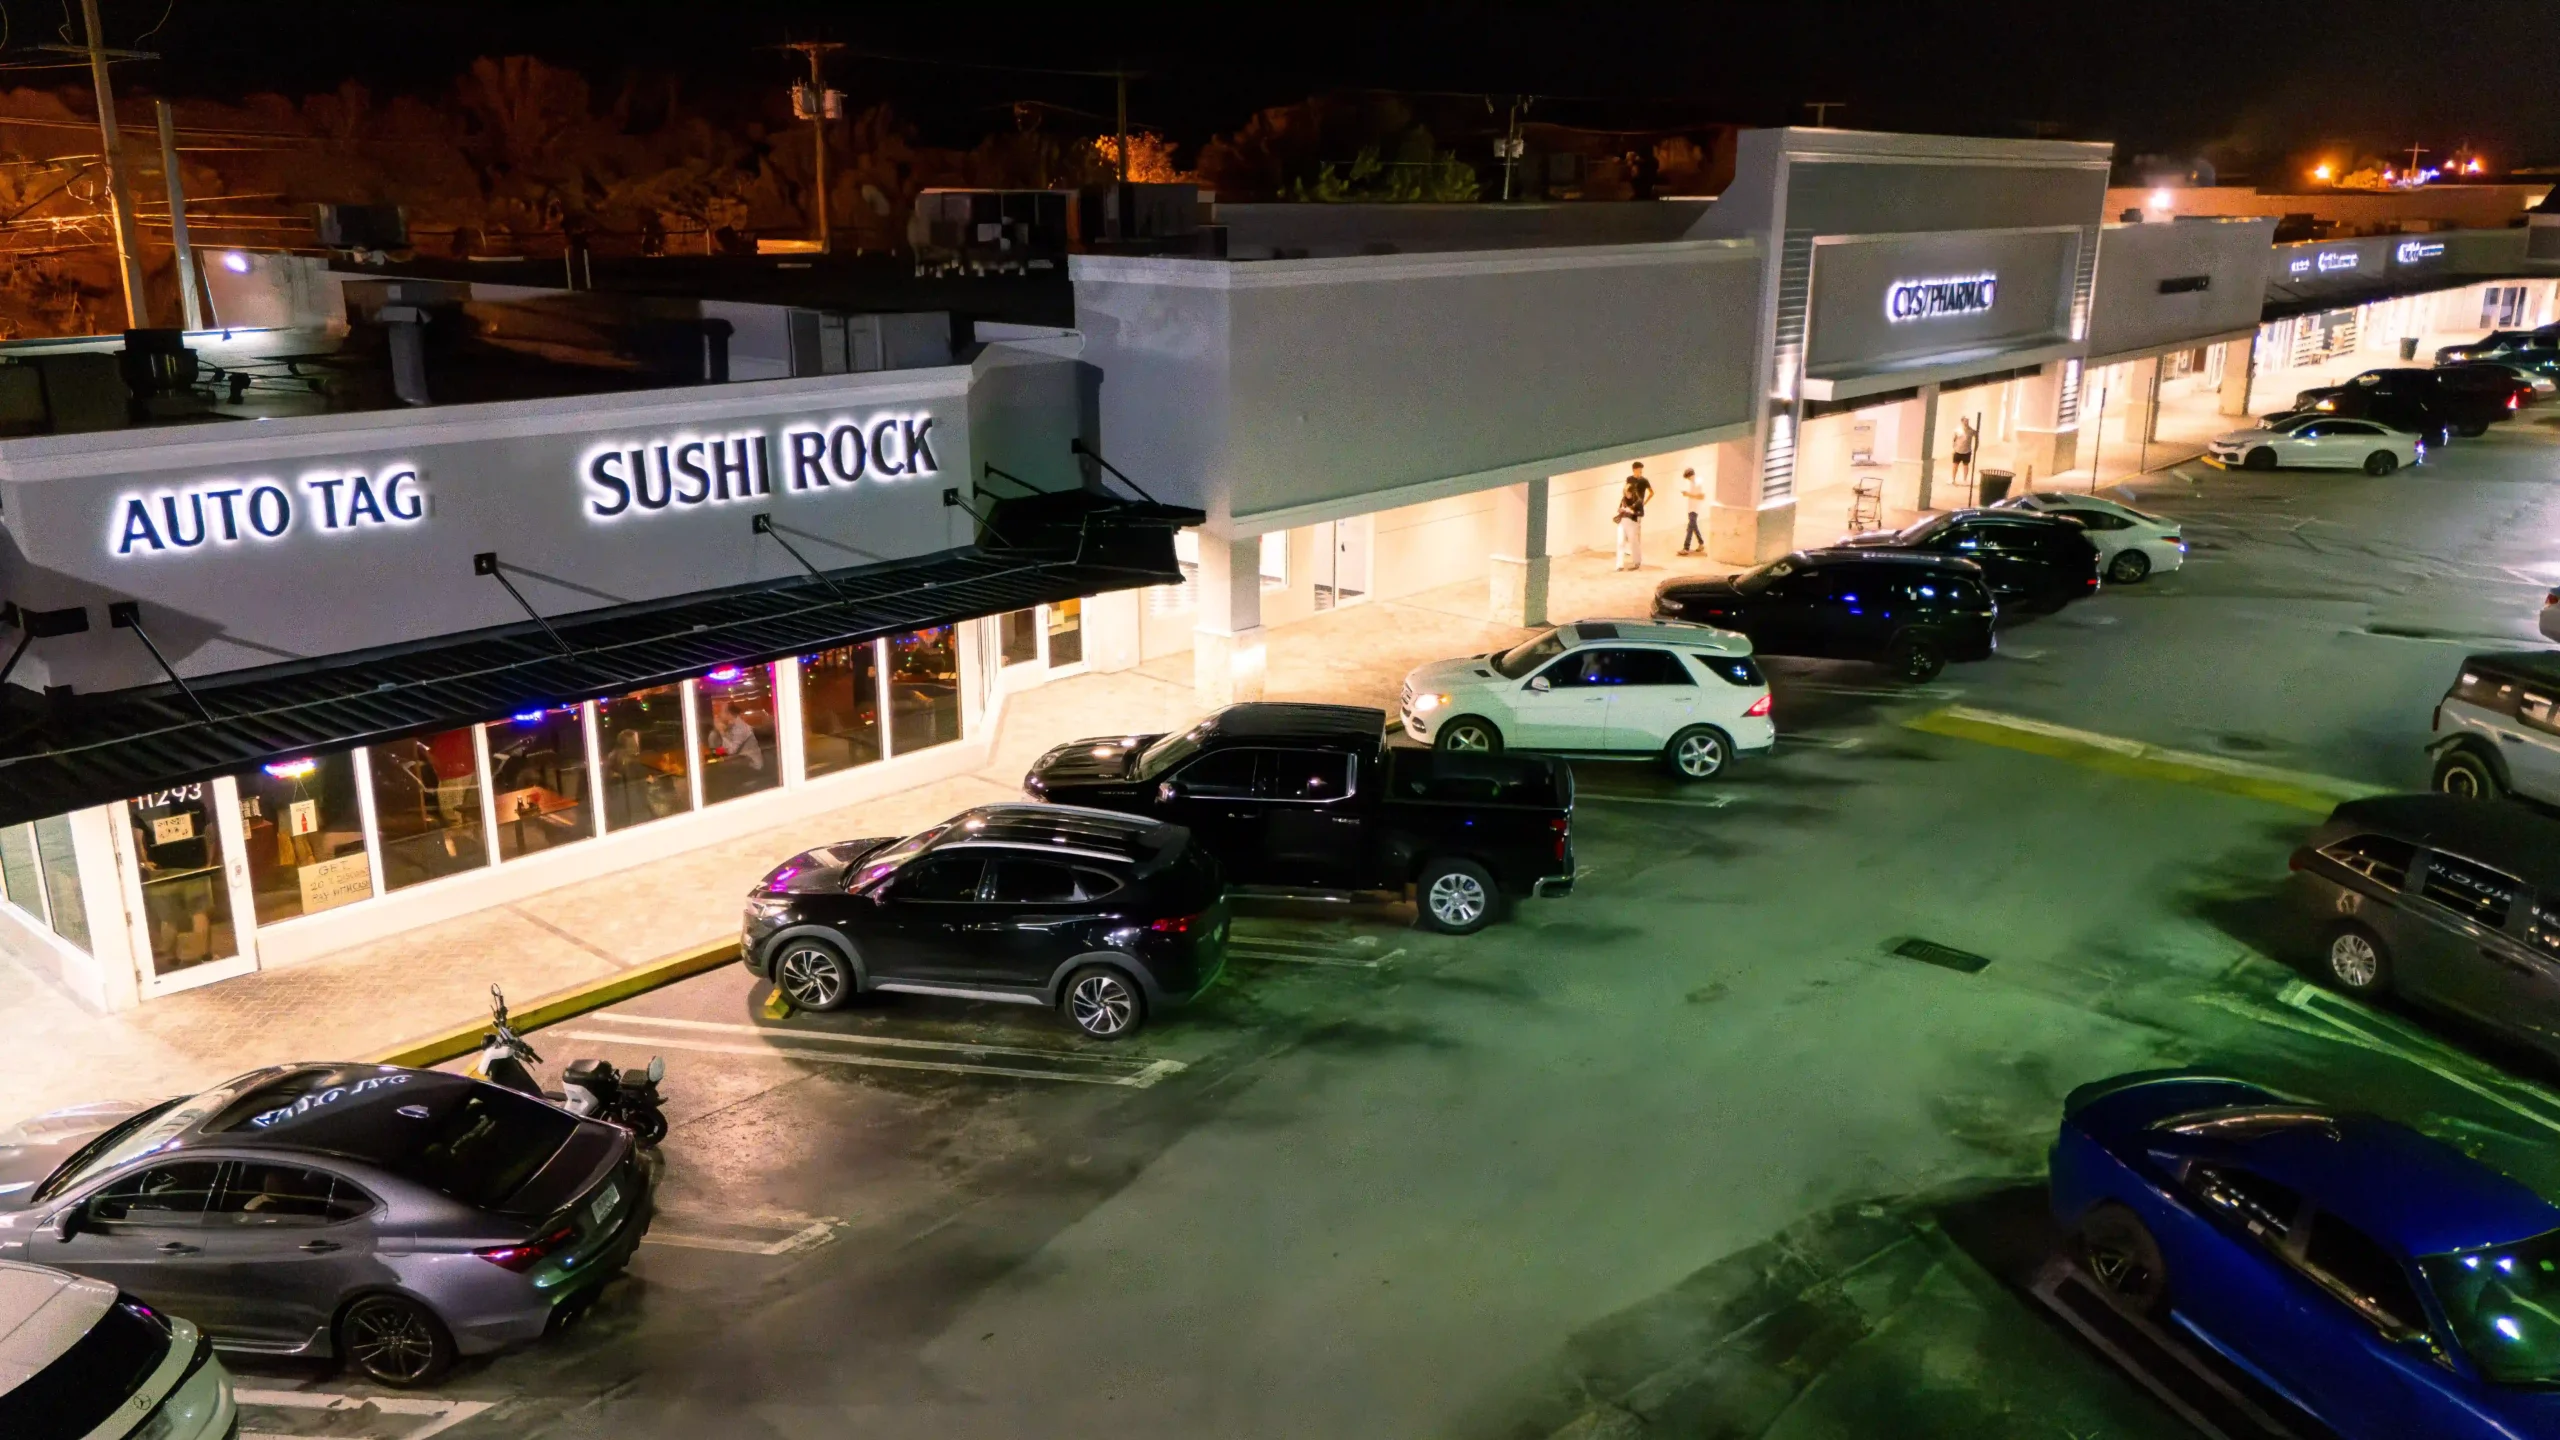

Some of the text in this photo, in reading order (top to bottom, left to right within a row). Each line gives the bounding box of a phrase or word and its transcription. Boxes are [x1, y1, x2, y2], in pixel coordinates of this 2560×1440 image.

[117, 471, 423, 554] AUTO TAG
[588, 417, 938, 517] SUSHI ROCK
